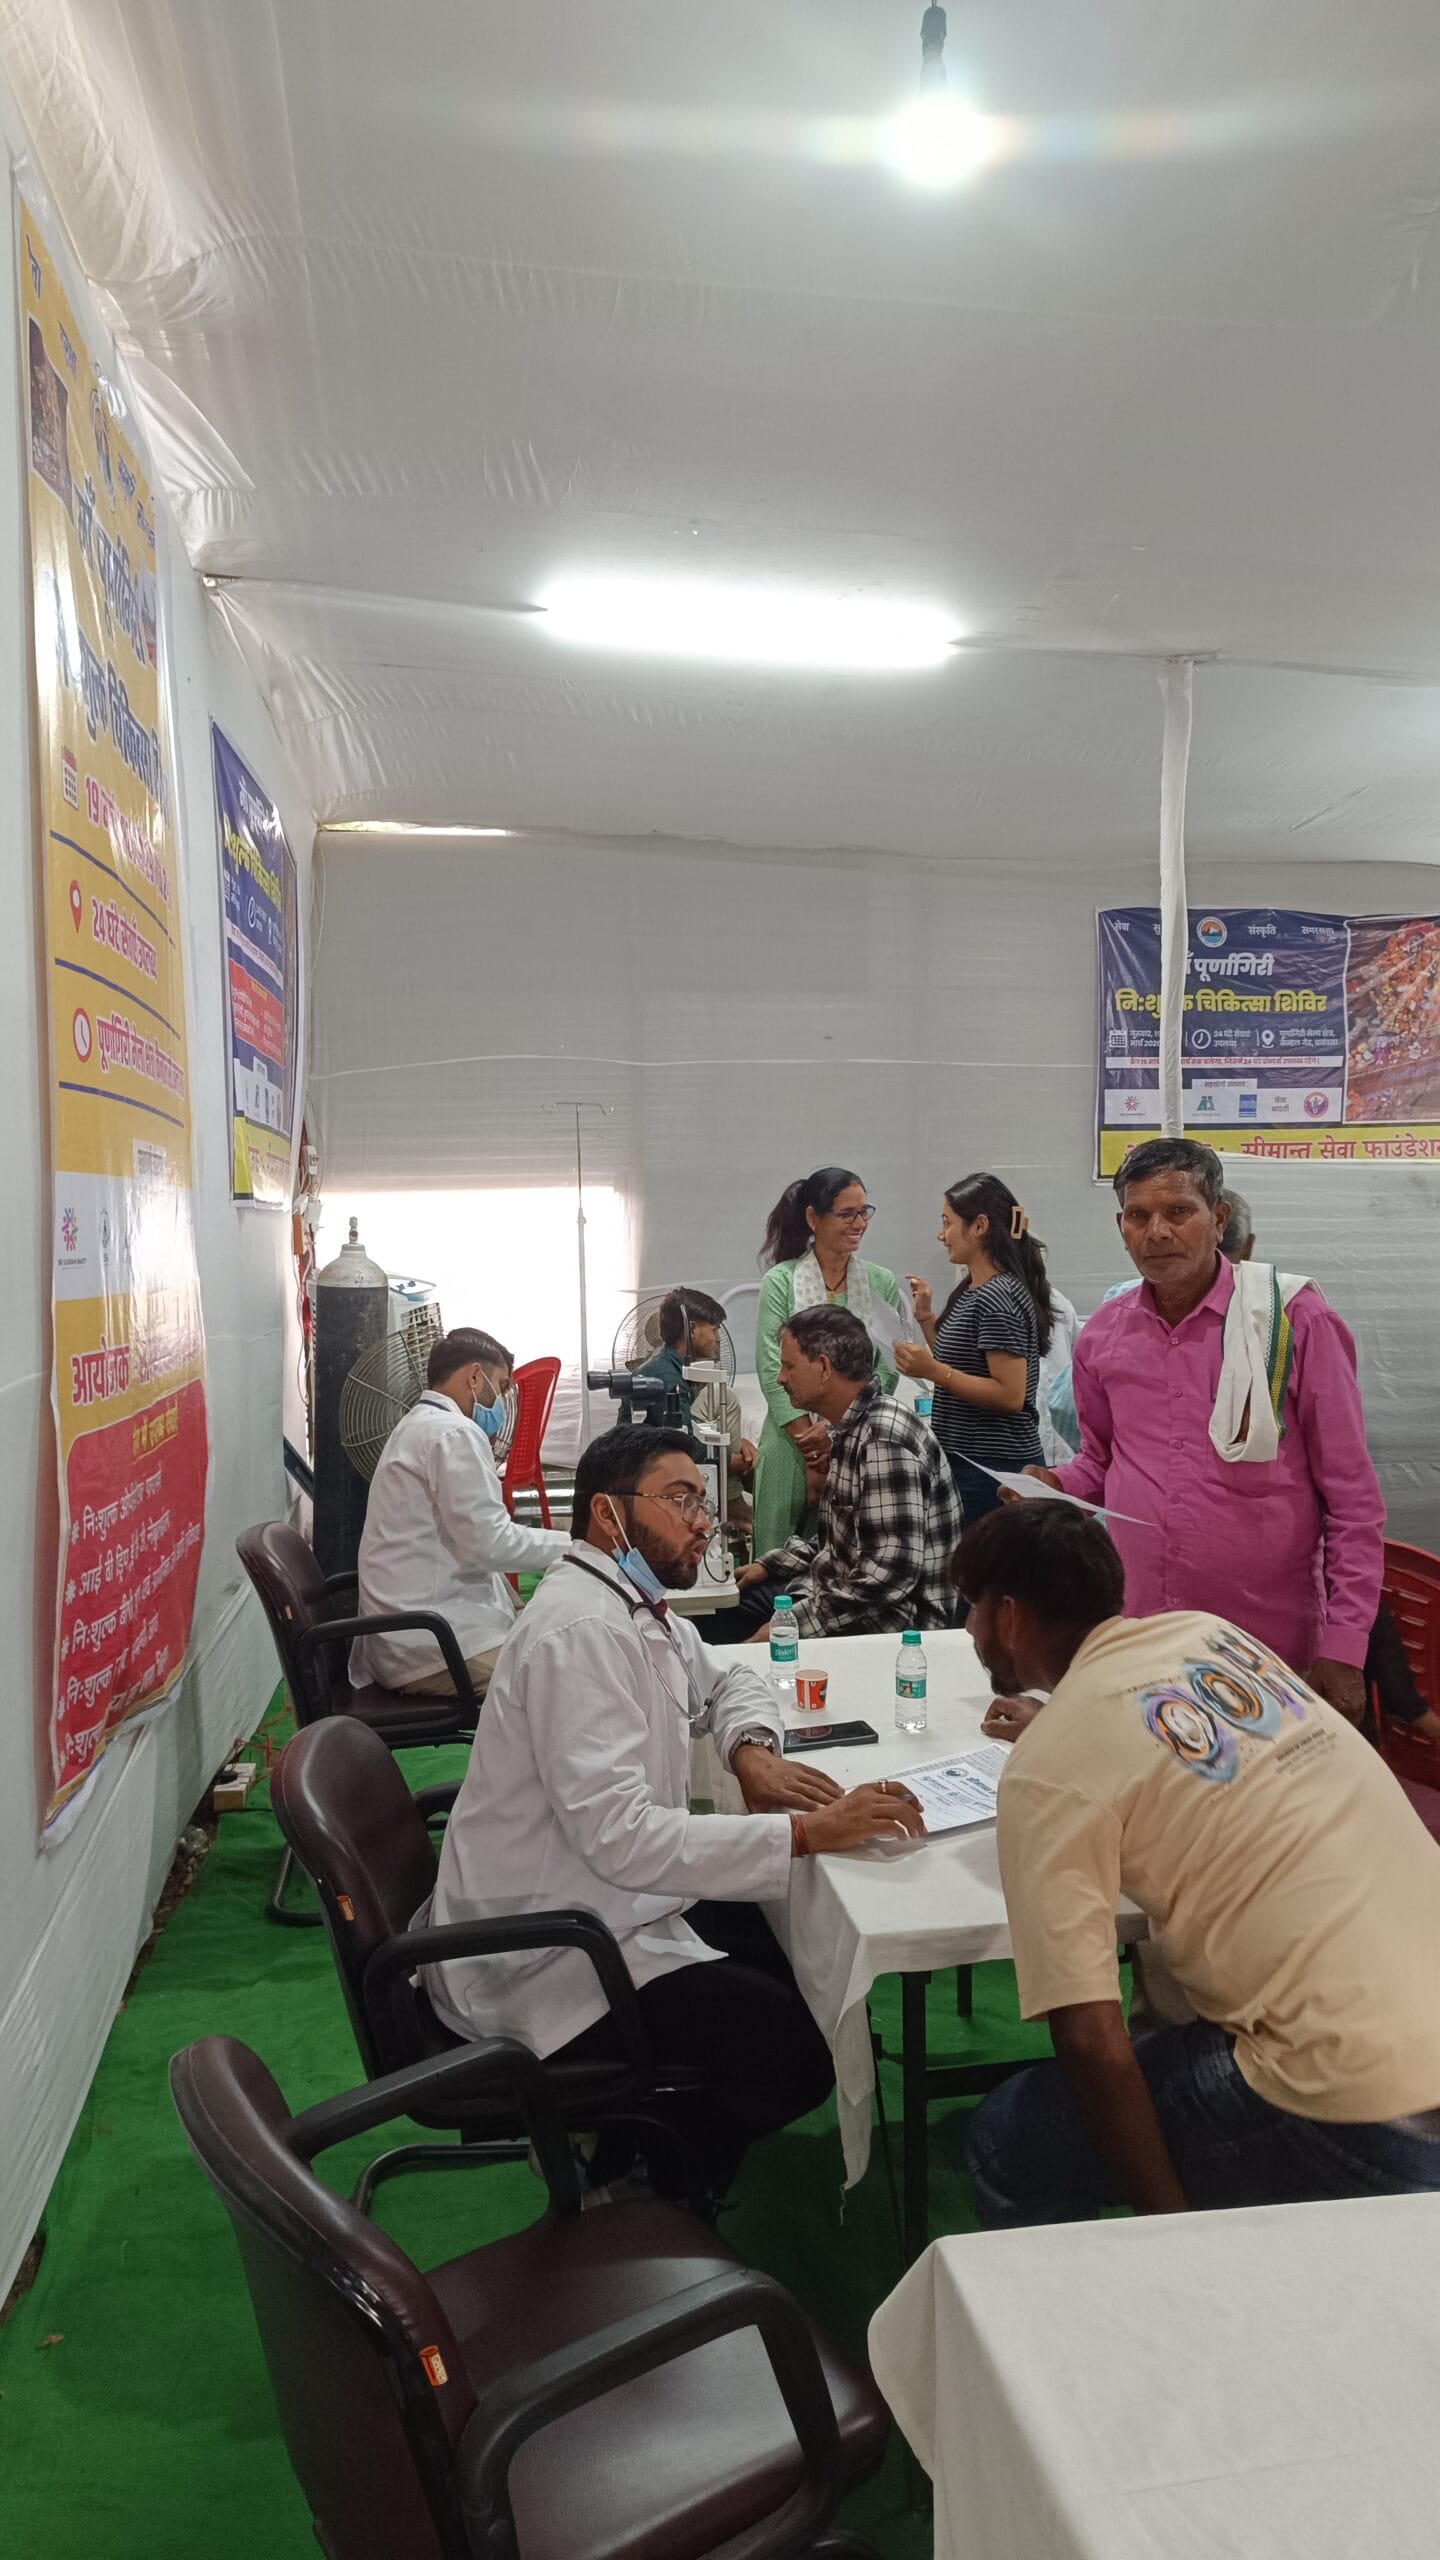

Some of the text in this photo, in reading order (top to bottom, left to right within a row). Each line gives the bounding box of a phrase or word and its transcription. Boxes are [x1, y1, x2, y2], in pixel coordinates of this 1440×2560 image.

[92, 898, 105, 942] 24
[1114, 919, 1130, 932] सेवा
[1248, 924, 1277, 938] संस्कृति
[1194, 952, 1275, 982] पूर्णागिरी
[1196, 988, 1272, 1012] चिकित्सा
[1273, 988, 1328, 1012] शिविर
[96, 1013, 130, 1073] पूर्णागिरी
[1318, 1134, 1357, 1159] सेवा
[72, 1336, 130, 1404] आयोजक
[79, 1554, 102, 1596] आई
[105, 1549, 113, 1582] वी
